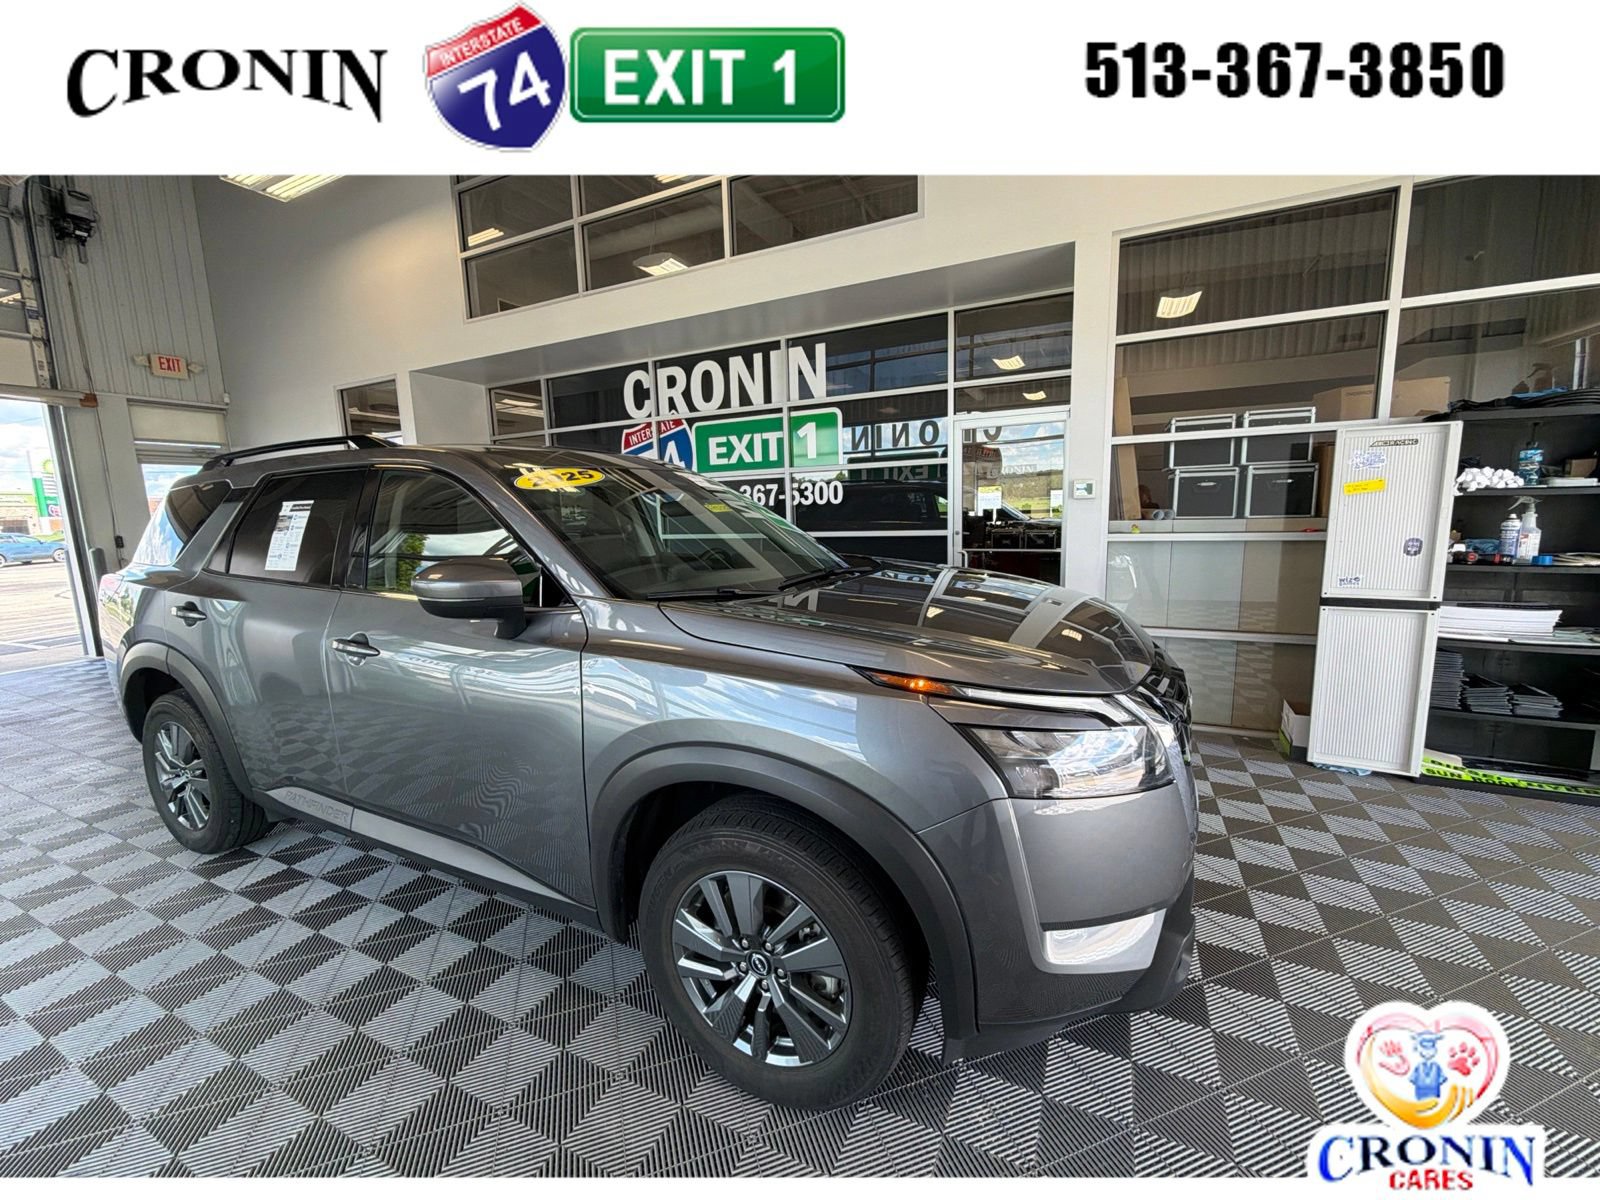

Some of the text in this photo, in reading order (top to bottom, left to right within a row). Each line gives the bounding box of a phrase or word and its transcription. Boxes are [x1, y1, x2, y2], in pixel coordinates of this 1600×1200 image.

[158, 356, 182, 373] EXIT
[623, 342, 827, 419] CRONIN
[708, 422, 817, 466] EXIT 1
